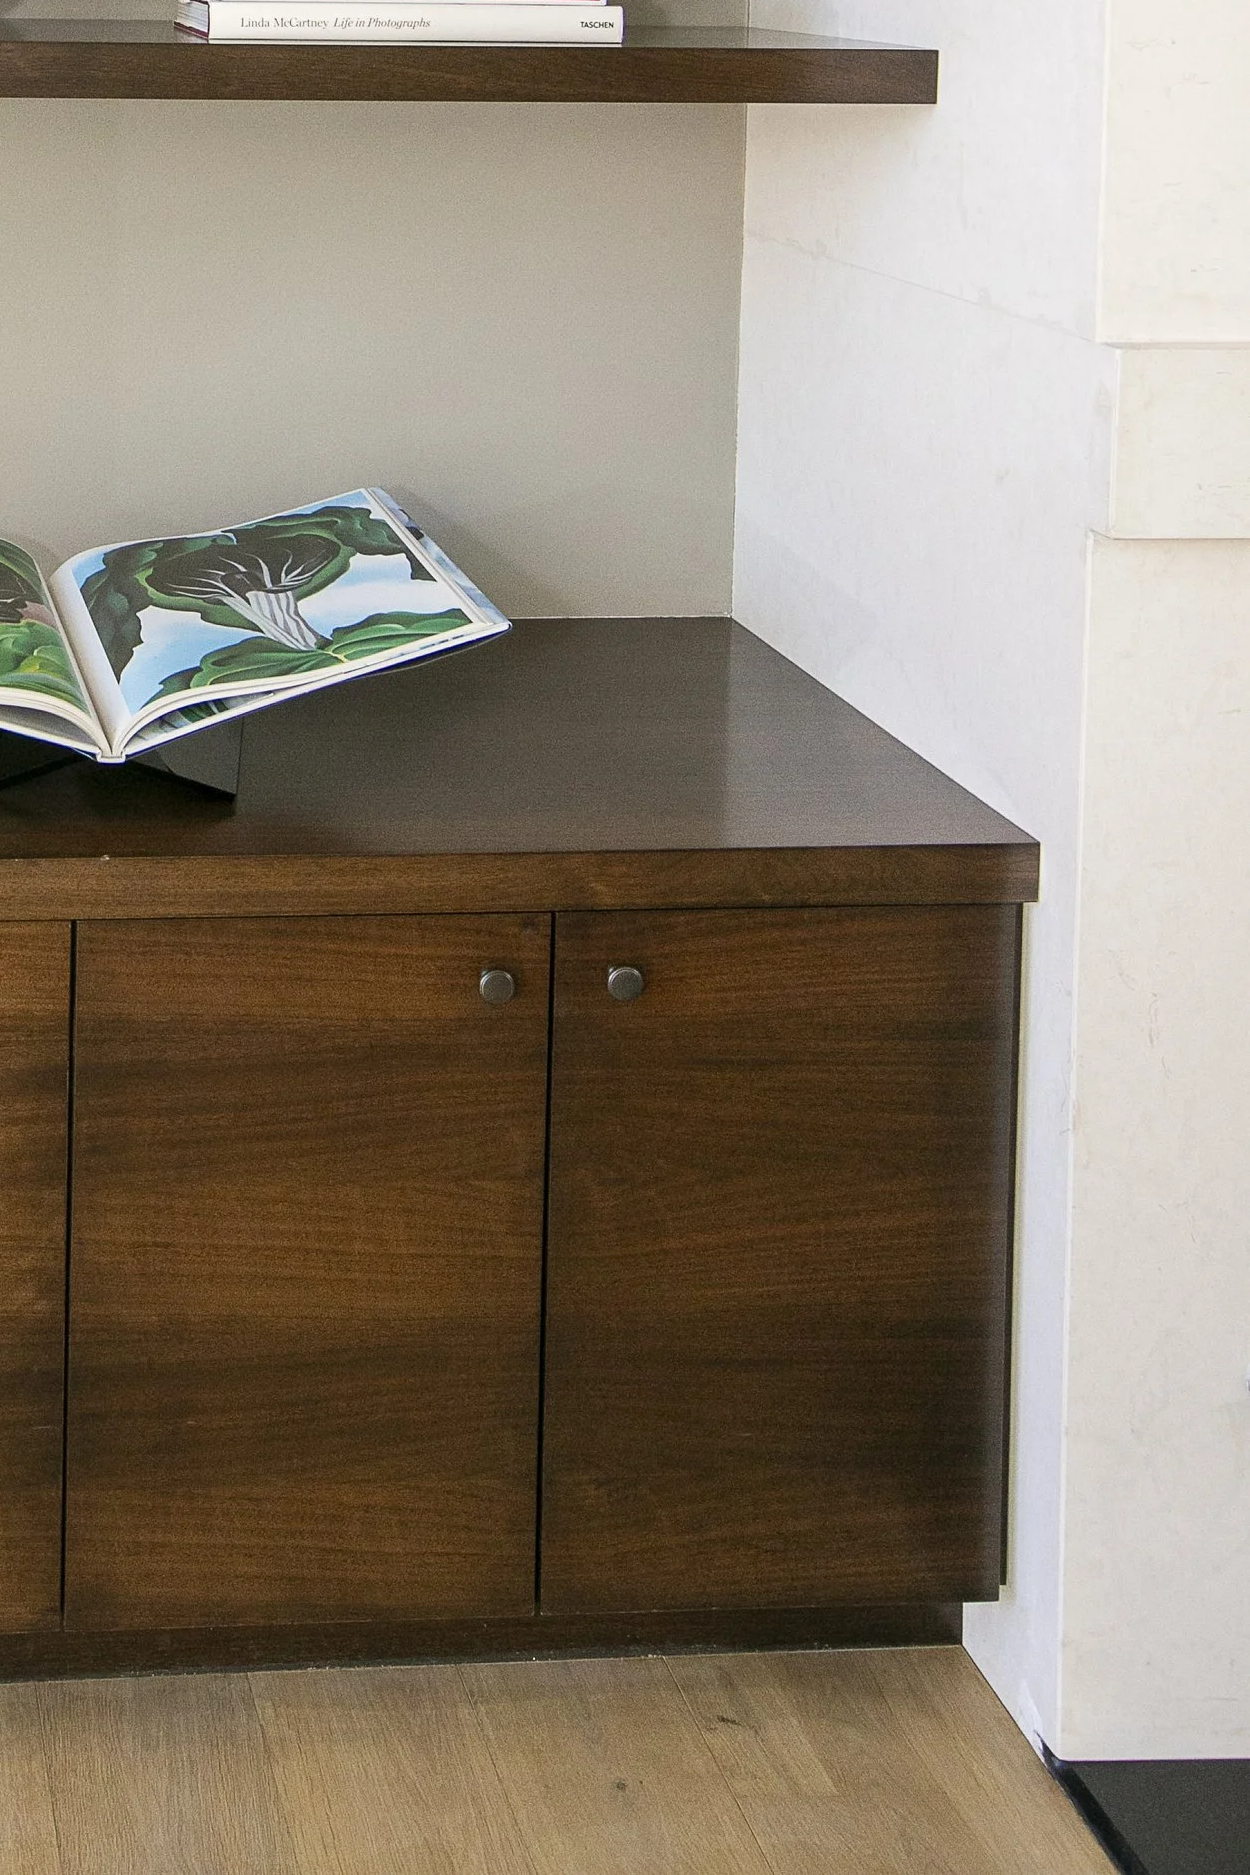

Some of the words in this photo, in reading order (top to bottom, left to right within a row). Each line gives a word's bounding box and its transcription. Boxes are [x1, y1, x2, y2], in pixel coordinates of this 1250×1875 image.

[240, 17, 270, 28] Linda
[273, 17, 329, 29] McCartney
[333, 17, 354, 29] Life
[355, 17, 366, 28] in
[367, 17, 431, 30] Photographs
[580, 20, 615, 29] TASCHEN
